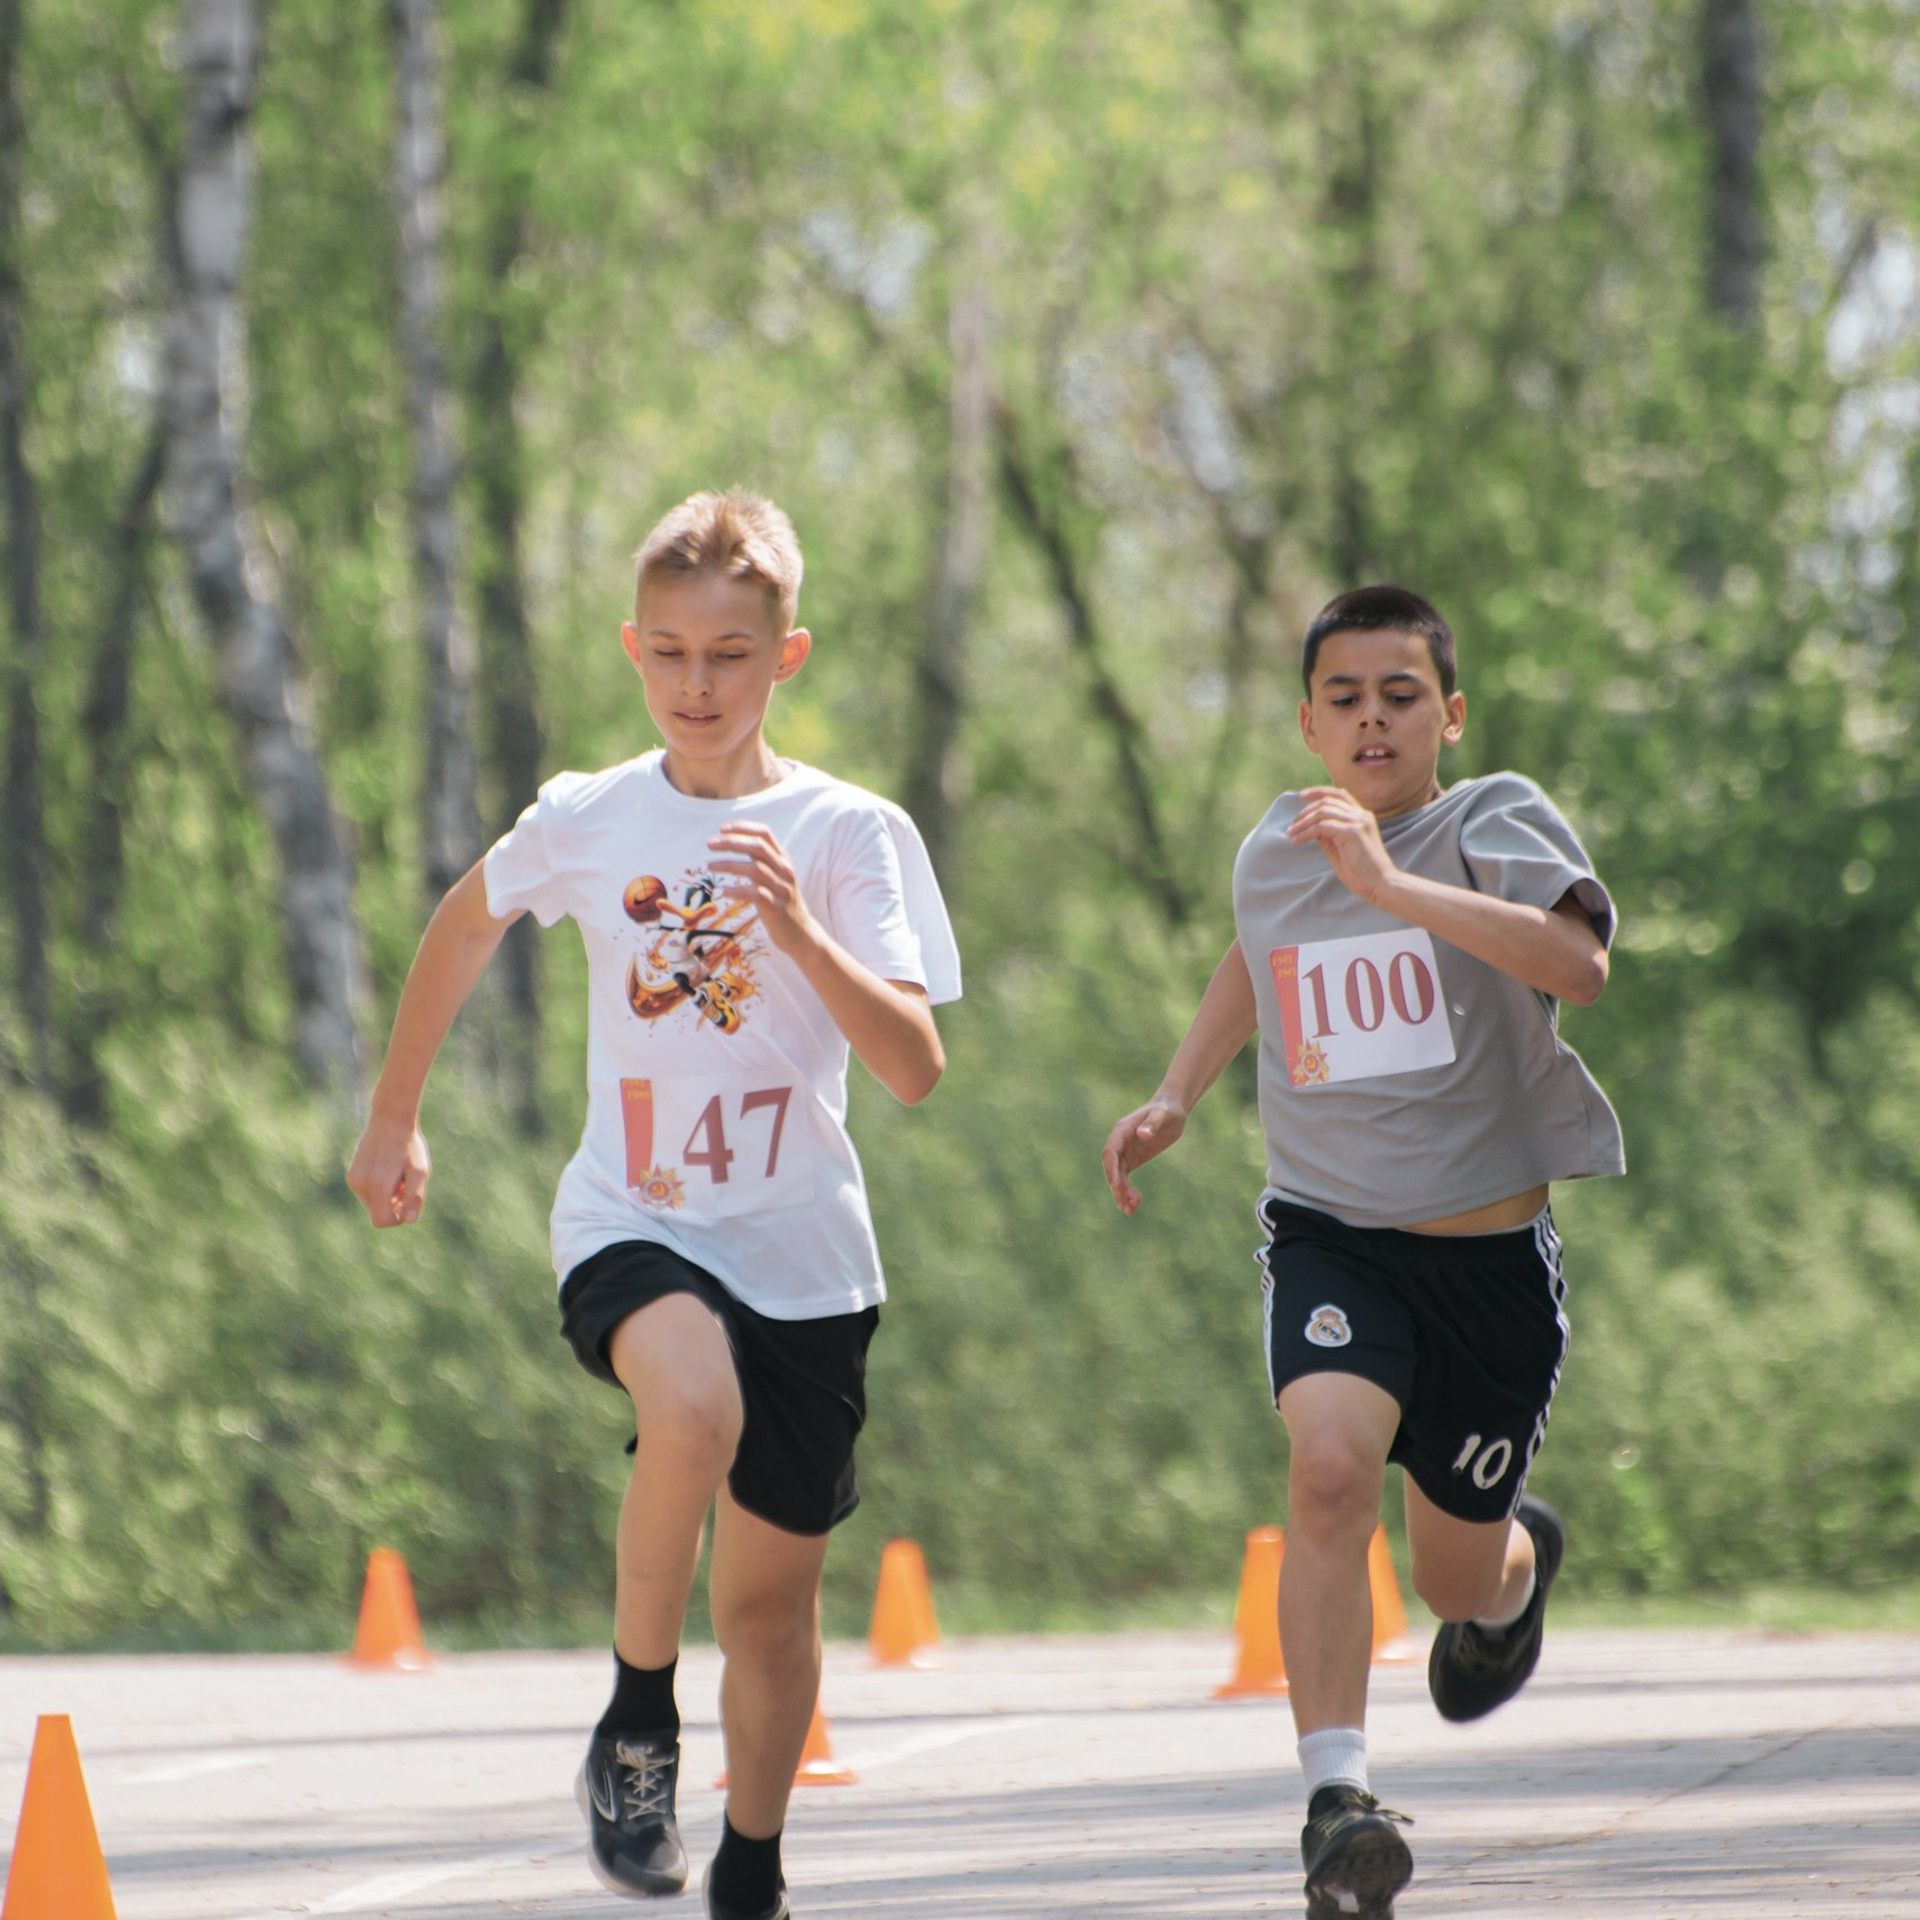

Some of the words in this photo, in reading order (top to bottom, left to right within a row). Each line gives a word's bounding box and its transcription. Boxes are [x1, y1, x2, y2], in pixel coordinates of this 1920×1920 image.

[1302, 951, 1435, 1038] 100
[683, 1086, 793, 1184] 47
[1452, 1433, 1512, 1489] 10
